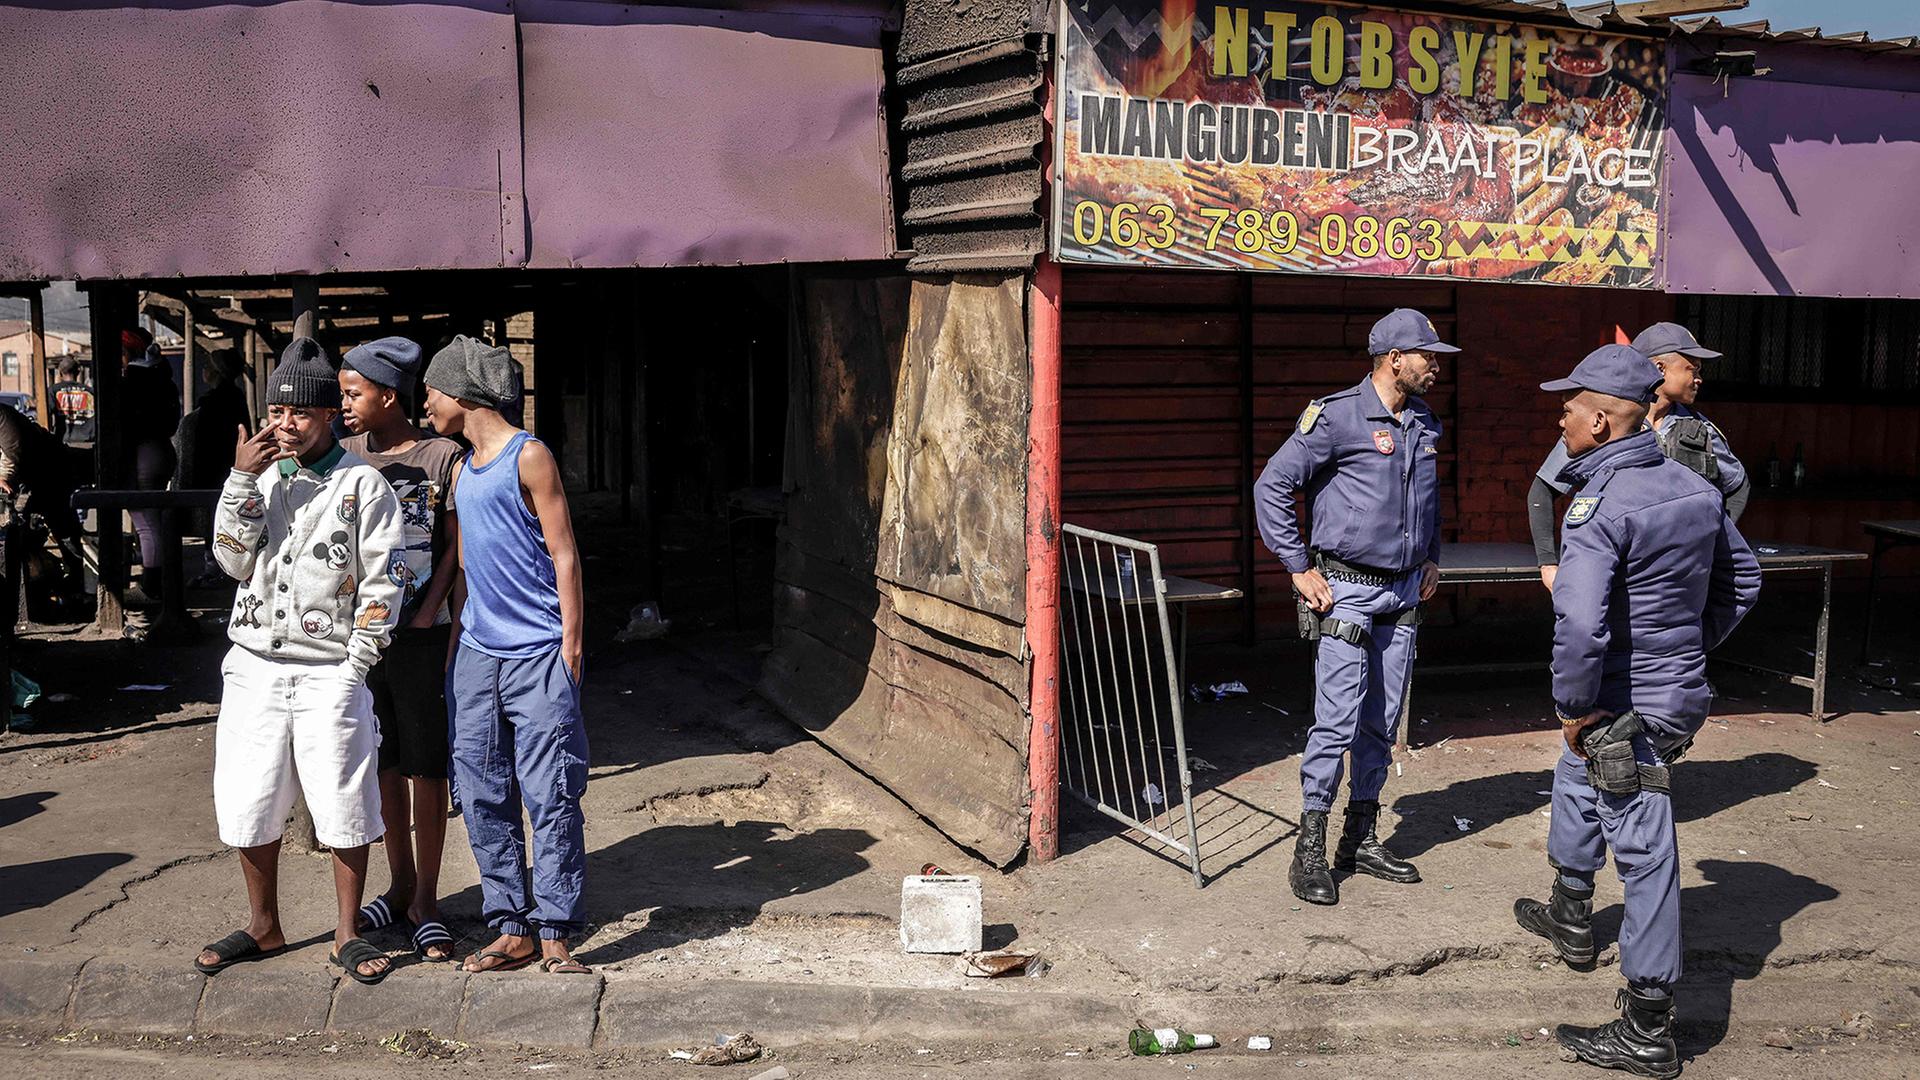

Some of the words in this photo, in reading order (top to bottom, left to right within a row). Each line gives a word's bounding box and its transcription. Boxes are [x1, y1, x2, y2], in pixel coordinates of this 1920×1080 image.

[1213, 6, 1550, 104] NTOBSYIE
[1079, 94, 1351, 171] MANGUBENI
[1352, 126, 1502, 179] BRAAI
[1512, 139, 1654, 188] PLACE
[1072, 200, 1177, 250] 063
[1199, 206, 1299, 255] 789
[1318, 213, 1444, 262] 0863
